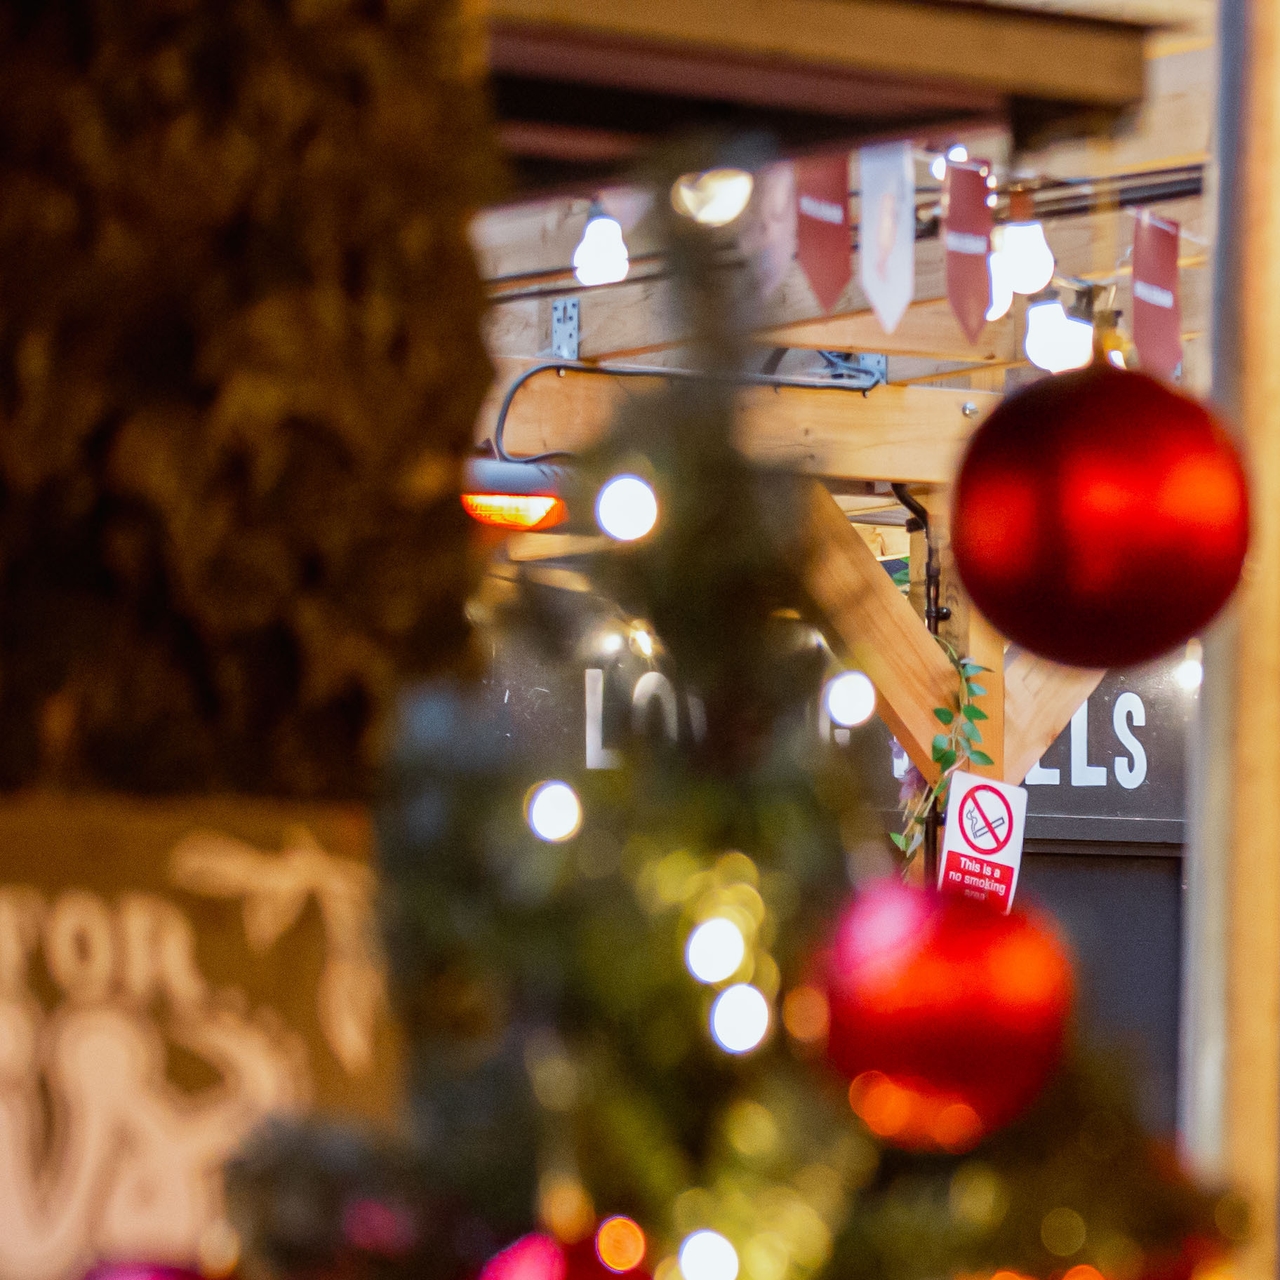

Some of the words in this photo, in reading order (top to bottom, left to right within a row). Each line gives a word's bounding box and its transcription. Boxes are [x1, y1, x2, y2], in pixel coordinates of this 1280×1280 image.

[960, 856, 981, 873] This
[983, 863, 992, 876] is
[994, 868, 1001, 878] a
[948, 871, 962, 882] no
[964, 875, 1006, 896] smoking
